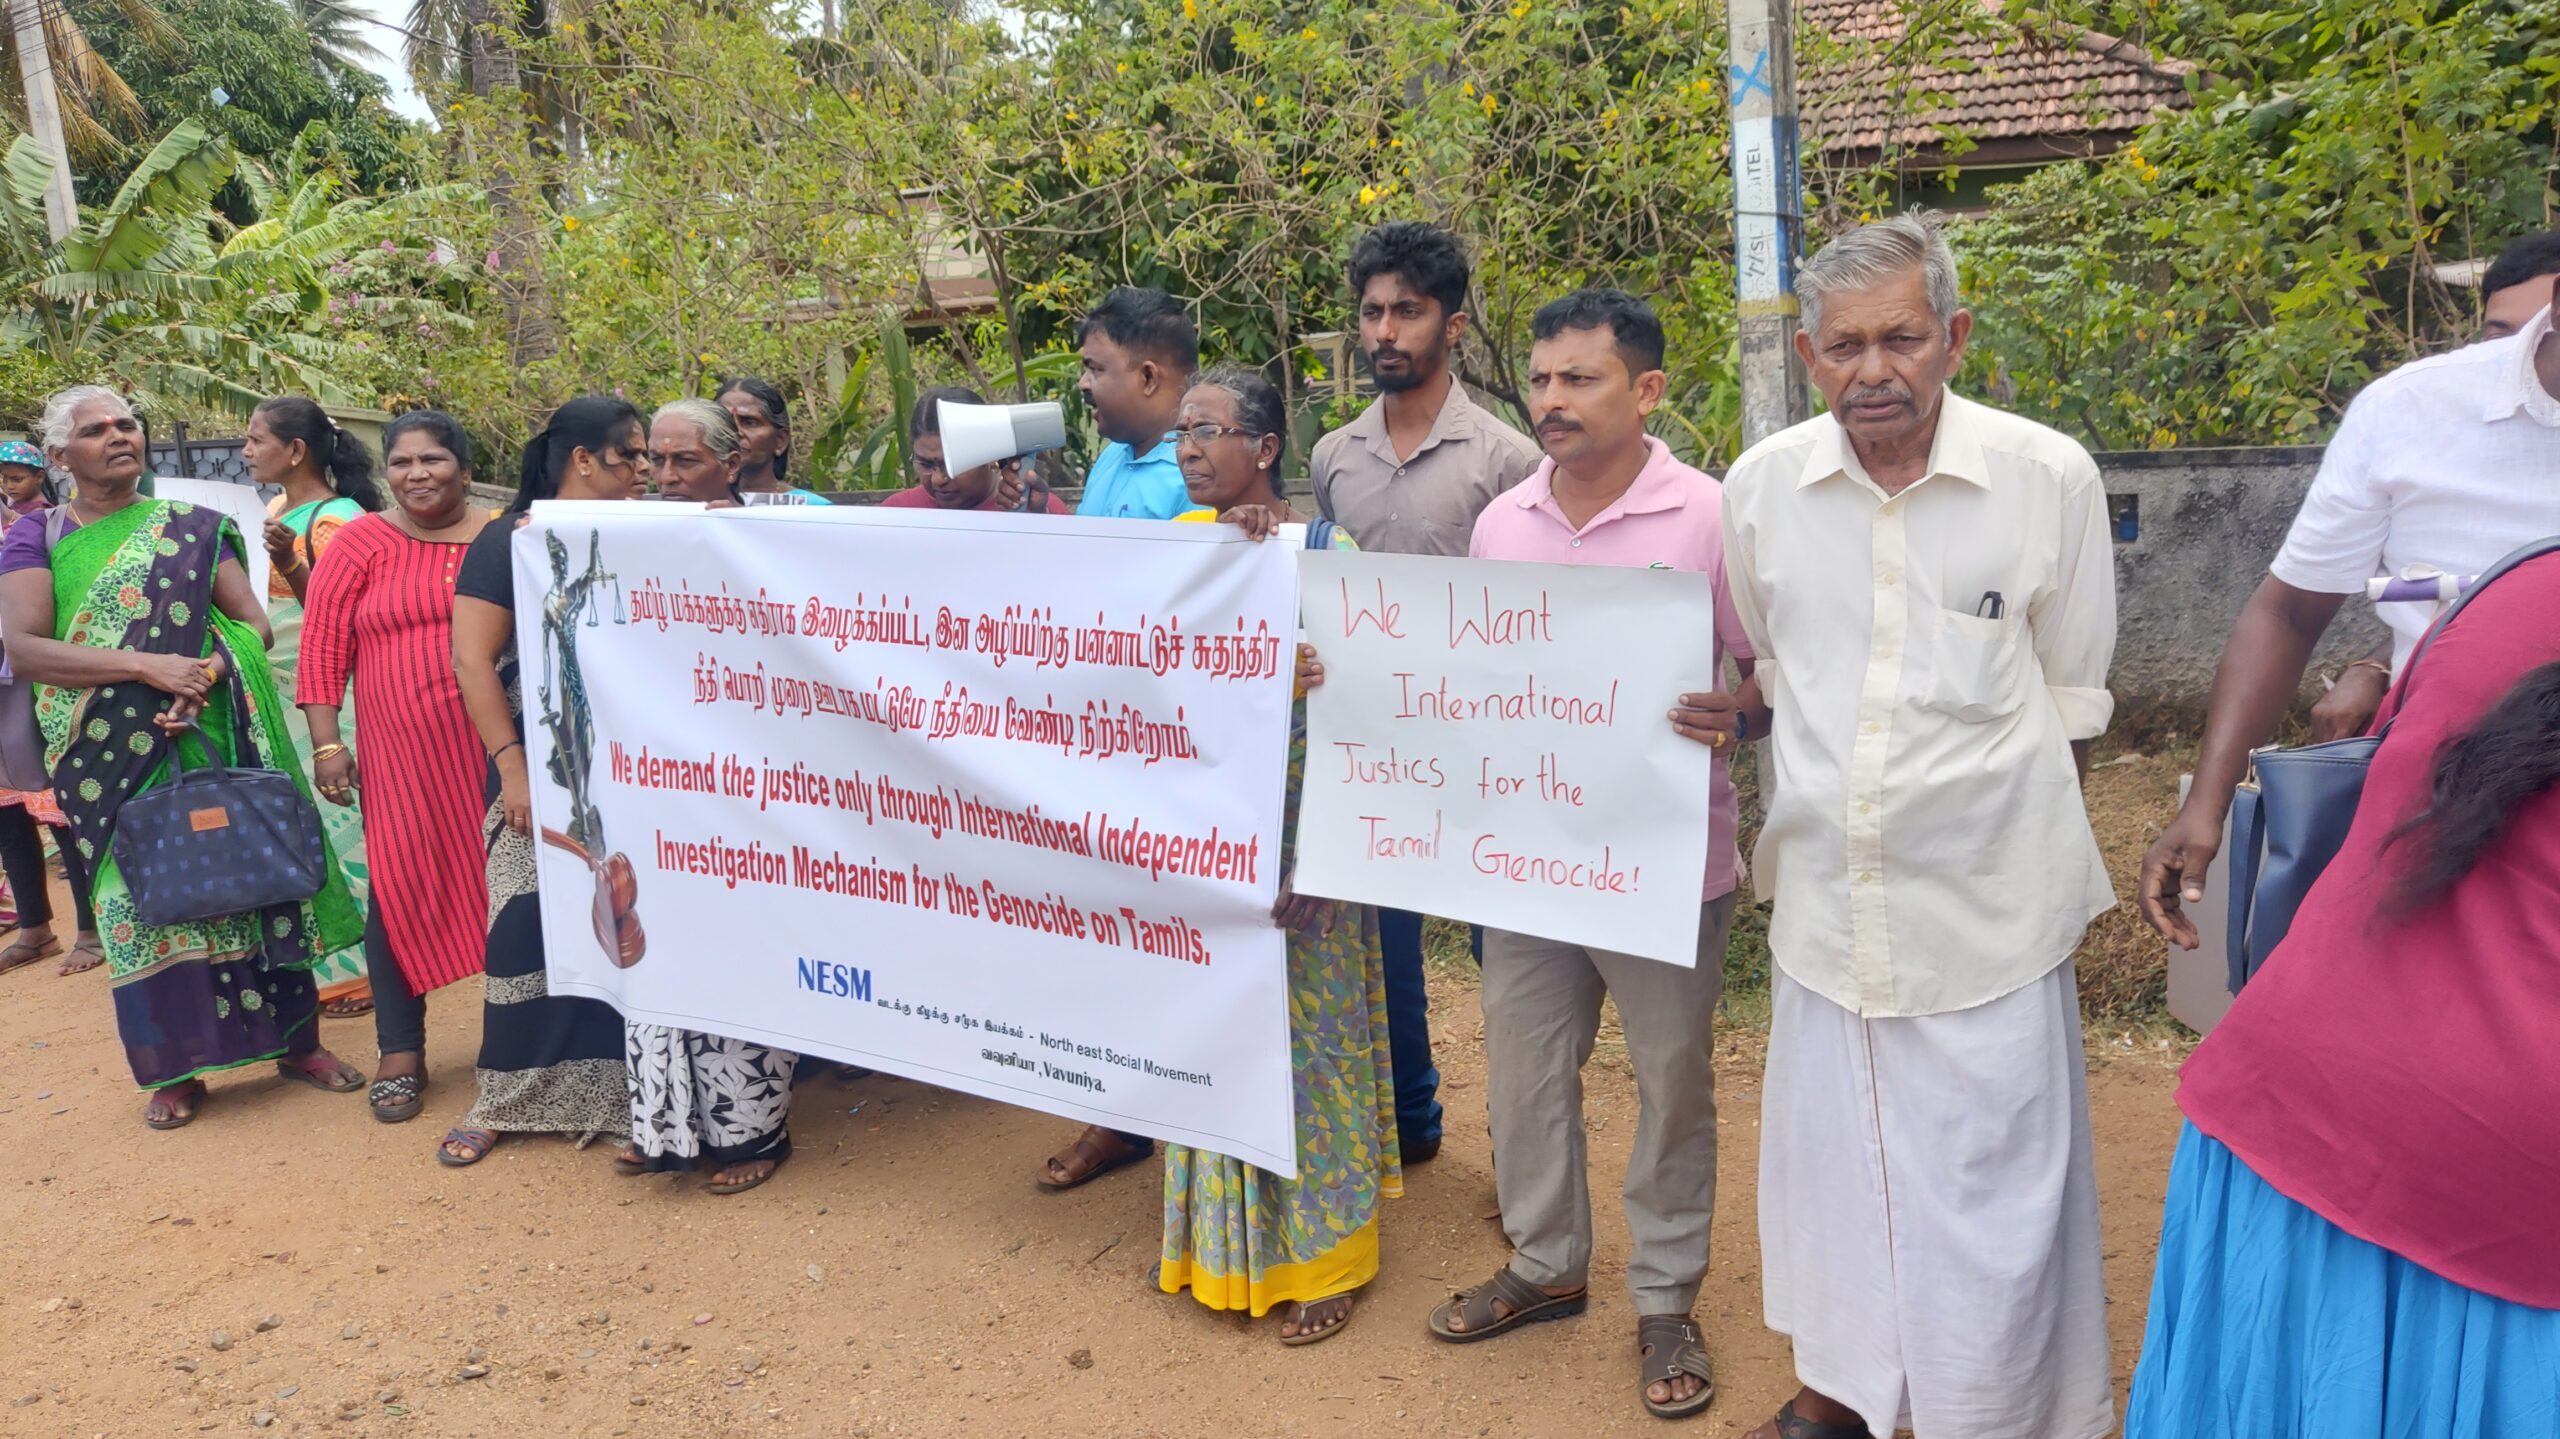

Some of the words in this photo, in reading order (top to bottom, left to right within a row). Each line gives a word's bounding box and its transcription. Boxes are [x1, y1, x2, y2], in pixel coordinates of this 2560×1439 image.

[630, 576, 668, 632] தமிழ்
[672, 578, 746, 635] மக்களுக்கு
[747, 587, 795, 634] எதிராக
[936, 606, 969, 649] இன
[975, 604, 1069, 669] அழிப்பிற்கு
[1074, 610, 1185, 678] பன்னாட்டுச்
[1192, 615, 1281, 684] சுதந்திர
[1341, 577, 1407, 640] We
[1448, 581, 1553, 649] Want
[861, 676, 926, 734] மட்டுமே
[926, 680, 1000, 743] நீதியை
[1005, 693, 1075, 757] வேண்டி
[1079, 697, 1199, 769] நிற்கிறோம்.
[1392, 672, 1619, 727] International
[609, 740, 633, 784] We
[637, 745, 717, 793] demand
[721, 753, 755, 799] the
[759, 757, 830, 811] justice
[834, 772, 873, 824] only
[877, 776, 953, 839] through
[955, 788, 1092, 856] International
[1097, 814, 1258, 883] Independent
[1333, 742, 1446, 788] Justics
[1477, 756, 1525, 799] for
[1536, 752, 1584, 807] the
[1359, 809, 1442, 861] Tamil
[1472, 834, 1641, 894] Genocide!
[656, 831, 786, 889] Investigation
[792, 847, 907, 903] Mechanism
[912, 864, 940, 909] for
[944, 876, 979, 918] the
[981, 879, 1085, 939] Genocide
[1090, 906, 1121, 946] on
[1118, 906, 1211, 966] Tamils.
[798, 956, 871, 1002] NESM
[1040, 1031, 1073, 1052] North
[1076, 1044, 1102, 1060] east
[1105, 1047, 1140, 1070] Social
[1143, 1058, 1212, 1086] Movement
